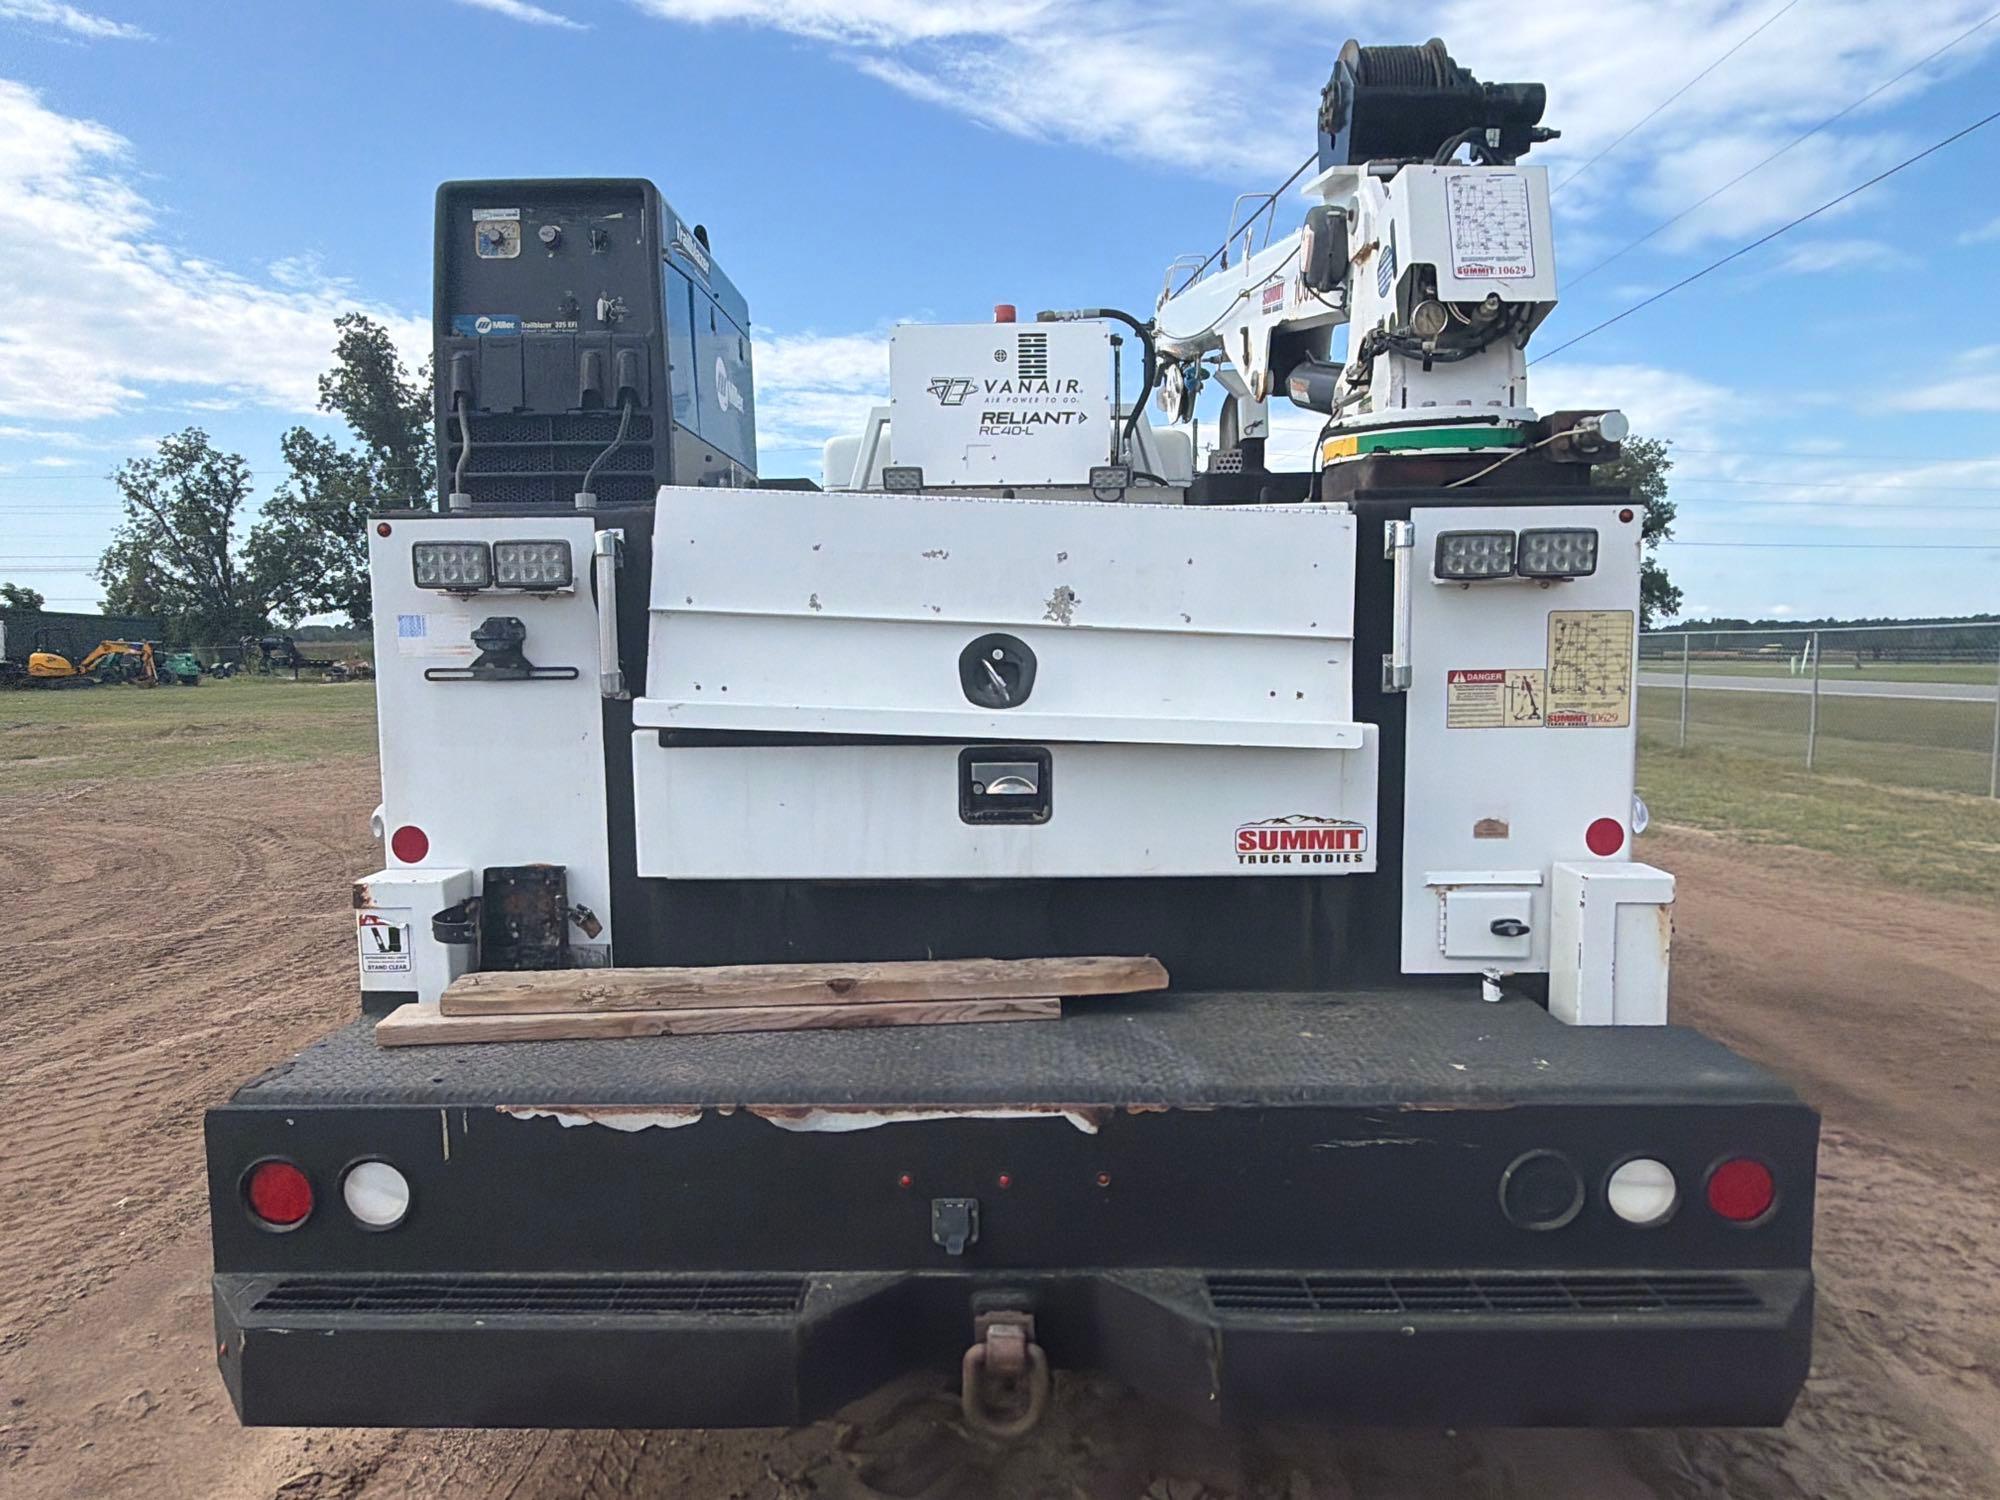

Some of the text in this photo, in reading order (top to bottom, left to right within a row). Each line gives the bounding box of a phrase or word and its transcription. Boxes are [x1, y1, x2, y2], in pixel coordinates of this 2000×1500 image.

[1498, 266, 1527, 275] 10629
[492, 321, 515, 329] Miller
[521, 321, 552, 329] Trailblazer
[984, 379, 1079, 394] VANAIR
[981, 412, 1076, 425] RELIANT
[979, 426, 1034, 436] RC40-L
[1467, 673, 1502, 681] DANGER
[1547, 714, 1588, 723] SUMMIT
[1238, 829, 1363, 851] SUMMIT
[1238, 853, 1363, 864] TRUCK BODIES
